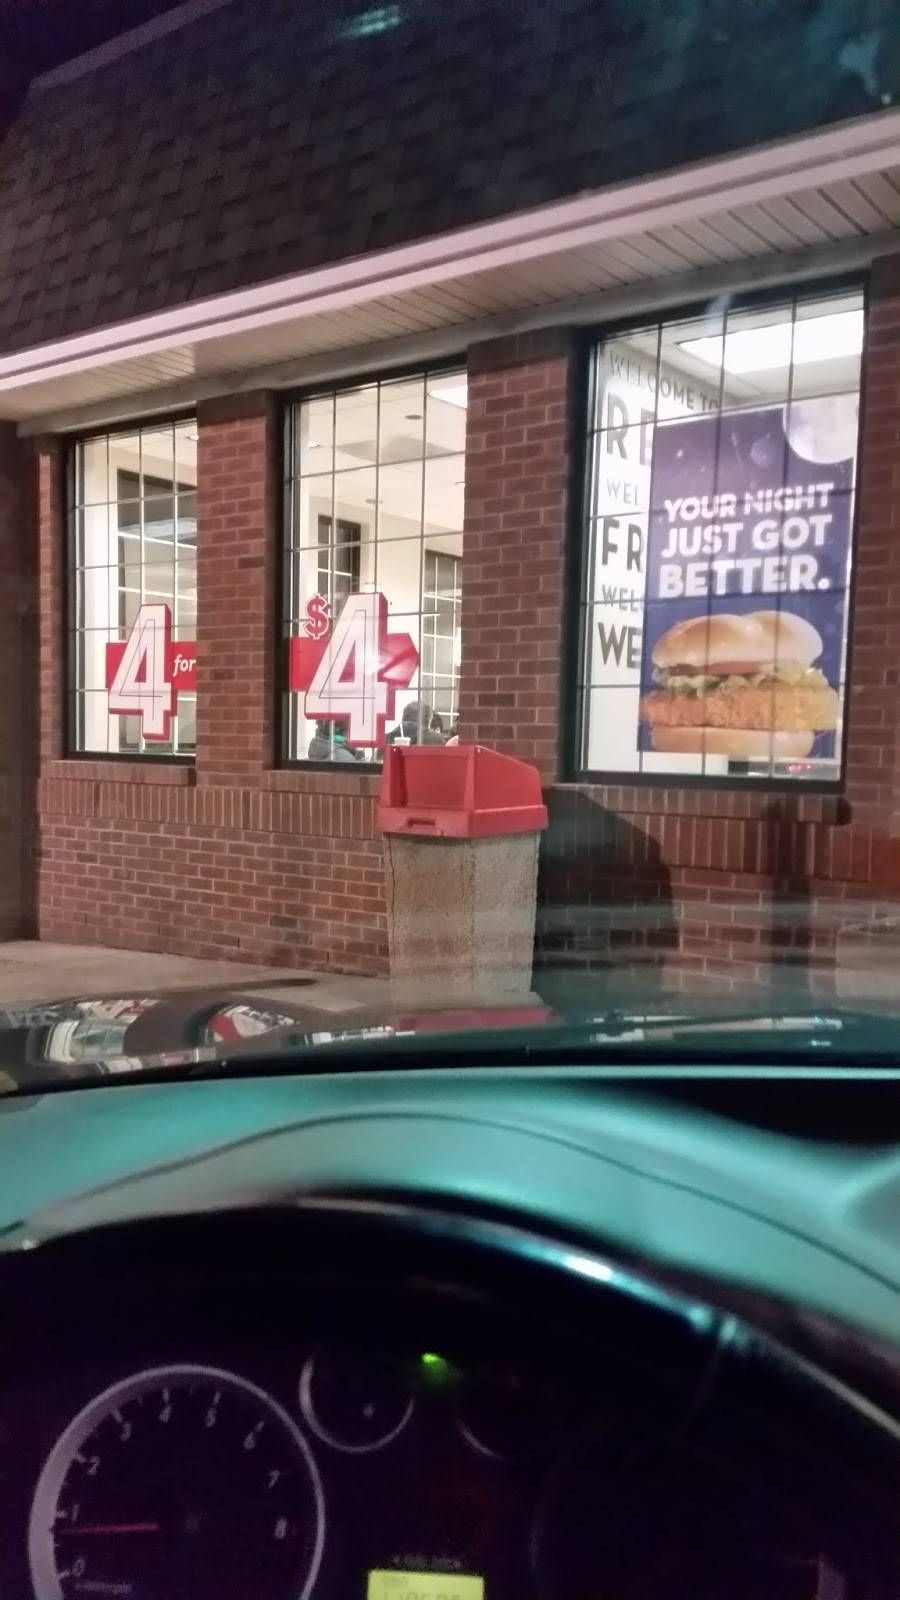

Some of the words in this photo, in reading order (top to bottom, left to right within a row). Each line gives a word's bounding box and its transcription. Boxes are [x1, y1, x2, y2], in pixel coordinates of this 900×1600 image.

[609, 350, 694, 410] WELCOME
[662, 493, 737, 523] YOUR
[744, 483, 834, 515] NIGHT
[602, 517, 644, 573] FR
[661, 522, 744, 558] JUST
[752, 514, 833, 551] GOT
[659, 554, 830, 598] BETTER.
[108, 603, 178, 740] 4
[172, 654, 197, 678] for
[87, 1456, 100, 1475] 2
[267, 1470, 281, 1490] 7
[71, 1504, 80, 1523] 1
